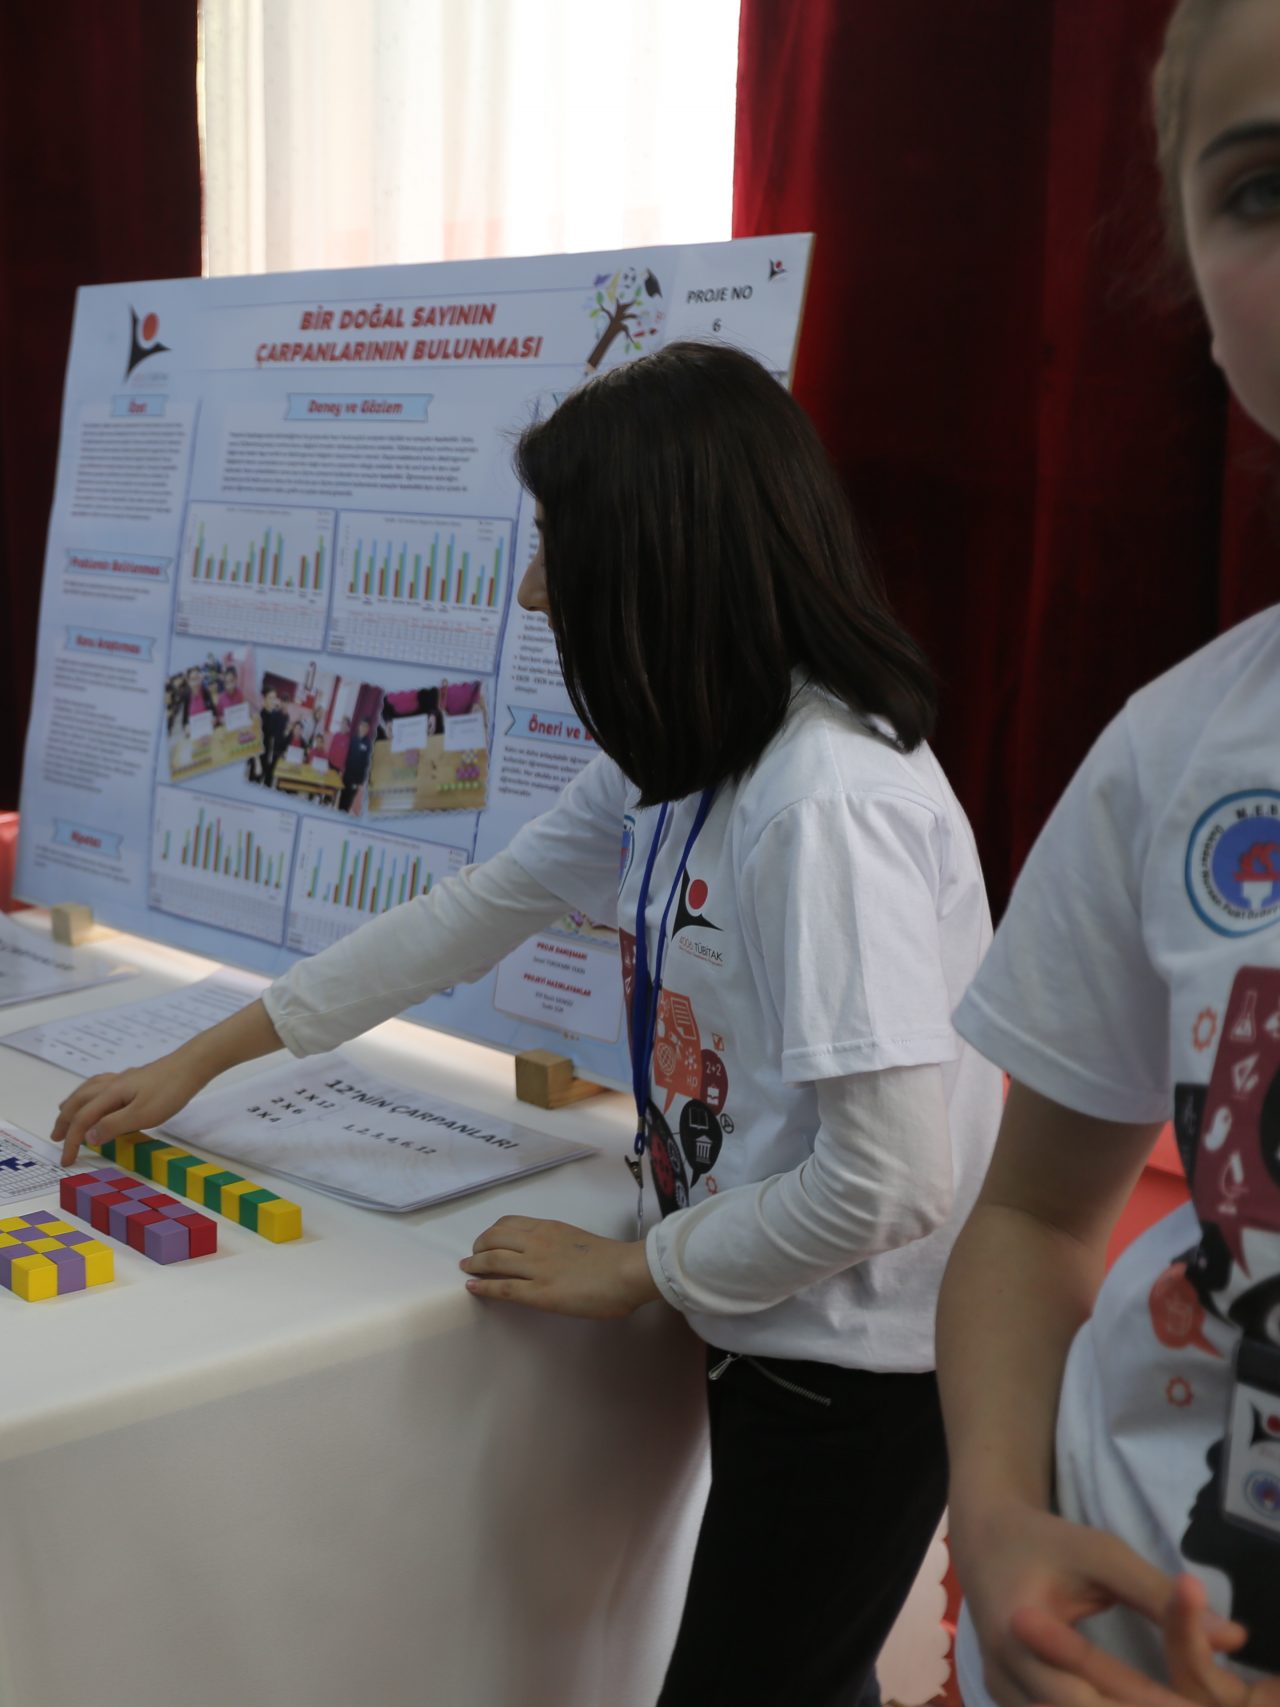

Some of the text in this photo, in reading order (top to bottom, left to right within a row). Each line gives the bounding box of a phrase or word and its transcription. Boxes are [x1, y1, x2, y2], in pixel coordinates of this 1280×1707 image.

[687, 285, 753, 304] PROJE NO
[299, 303, 497, 331] BİR DOĞAL SAYININ
[713, 318, 722, 332] 6
[255, 335, 544, 369] ÇARPANLARININ BULUNMASI
[308, 399, 403, 416] Deney ve Gözlem
[528, 712, 563, 737] Öneri
[566, 726, 581, 739] ve
[694, 941, 723, 962] TÜBİTAK
[705, 1060, 722, 1077] 2+2
[247, 1105, 261, 1113] 3
[271, 1097, 285, 1105] 2
[317, 1100, 336, 1109] 12
[389, 1104, 521, 1150] ÇARPANLARI
[415, 1146, 438, 1155] 12
